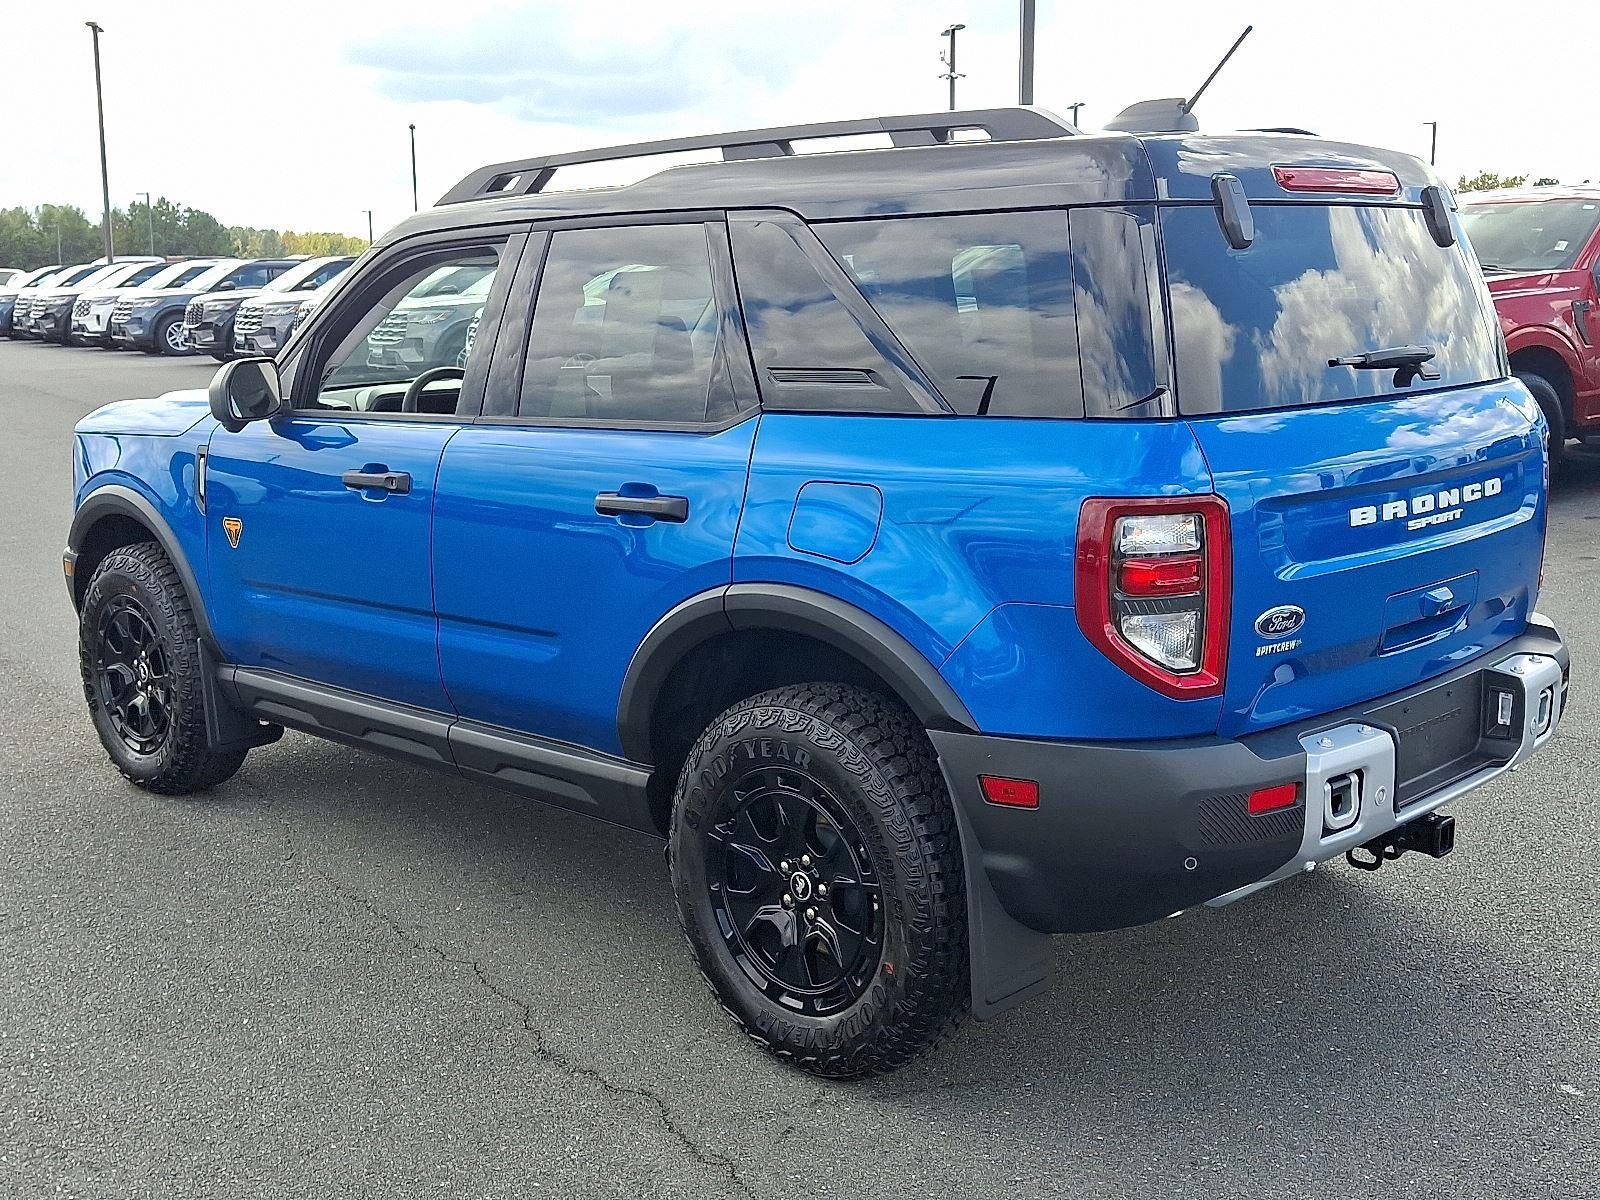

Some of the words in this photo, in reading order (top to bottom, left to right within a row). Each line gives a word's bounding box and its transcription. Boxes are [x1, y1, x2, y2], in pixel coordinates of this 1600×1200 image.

[1350, 478, 1502, 527] BRONCO
[1407, 508, 1464, 531] SPORT
[1268, 612, 1297, 632] Ford
